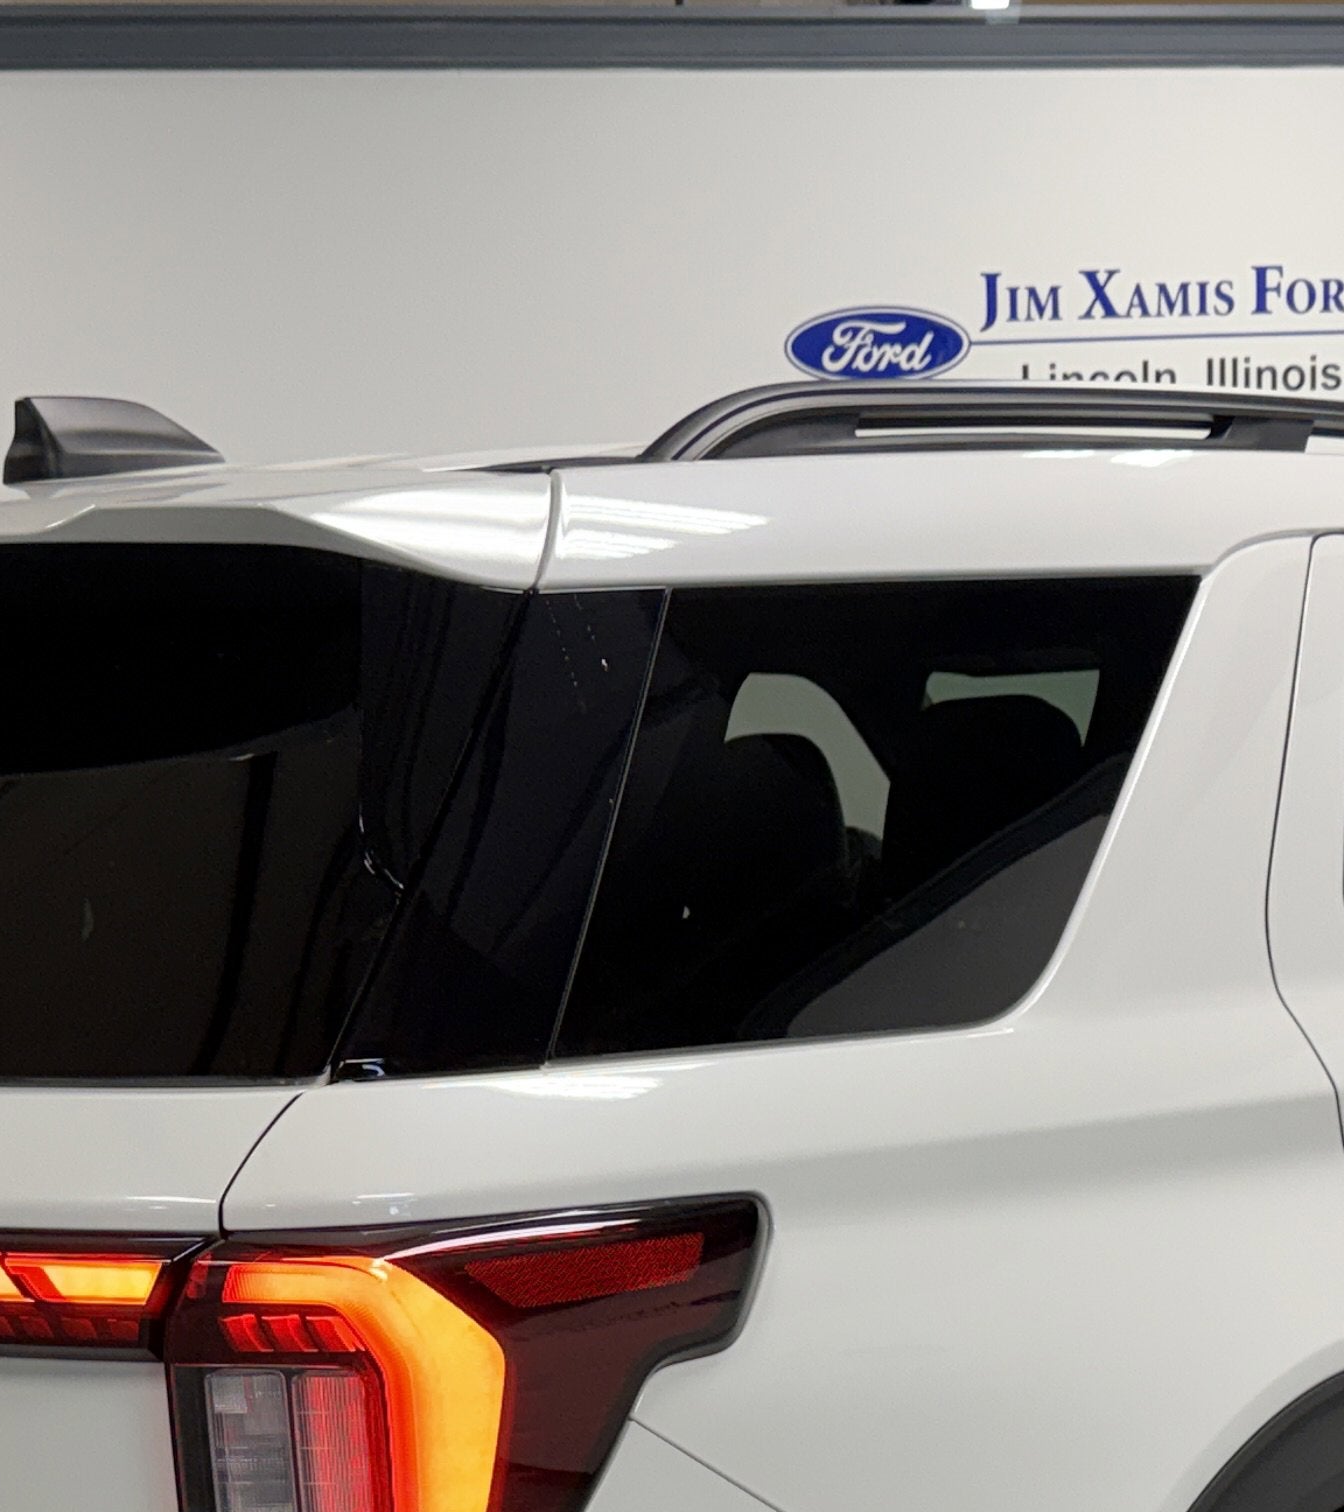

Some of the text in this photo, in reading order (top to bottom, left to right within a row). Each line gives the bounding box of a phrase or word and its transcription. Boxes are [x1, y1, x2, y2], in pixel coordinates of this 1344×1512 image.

[980, 271, 1062, 331] JIM
[1078, 269, 1235, 320] XAMIS
[822, 319, 932, 371] Ford
[1207, 355, 1342, 391] Illinois
